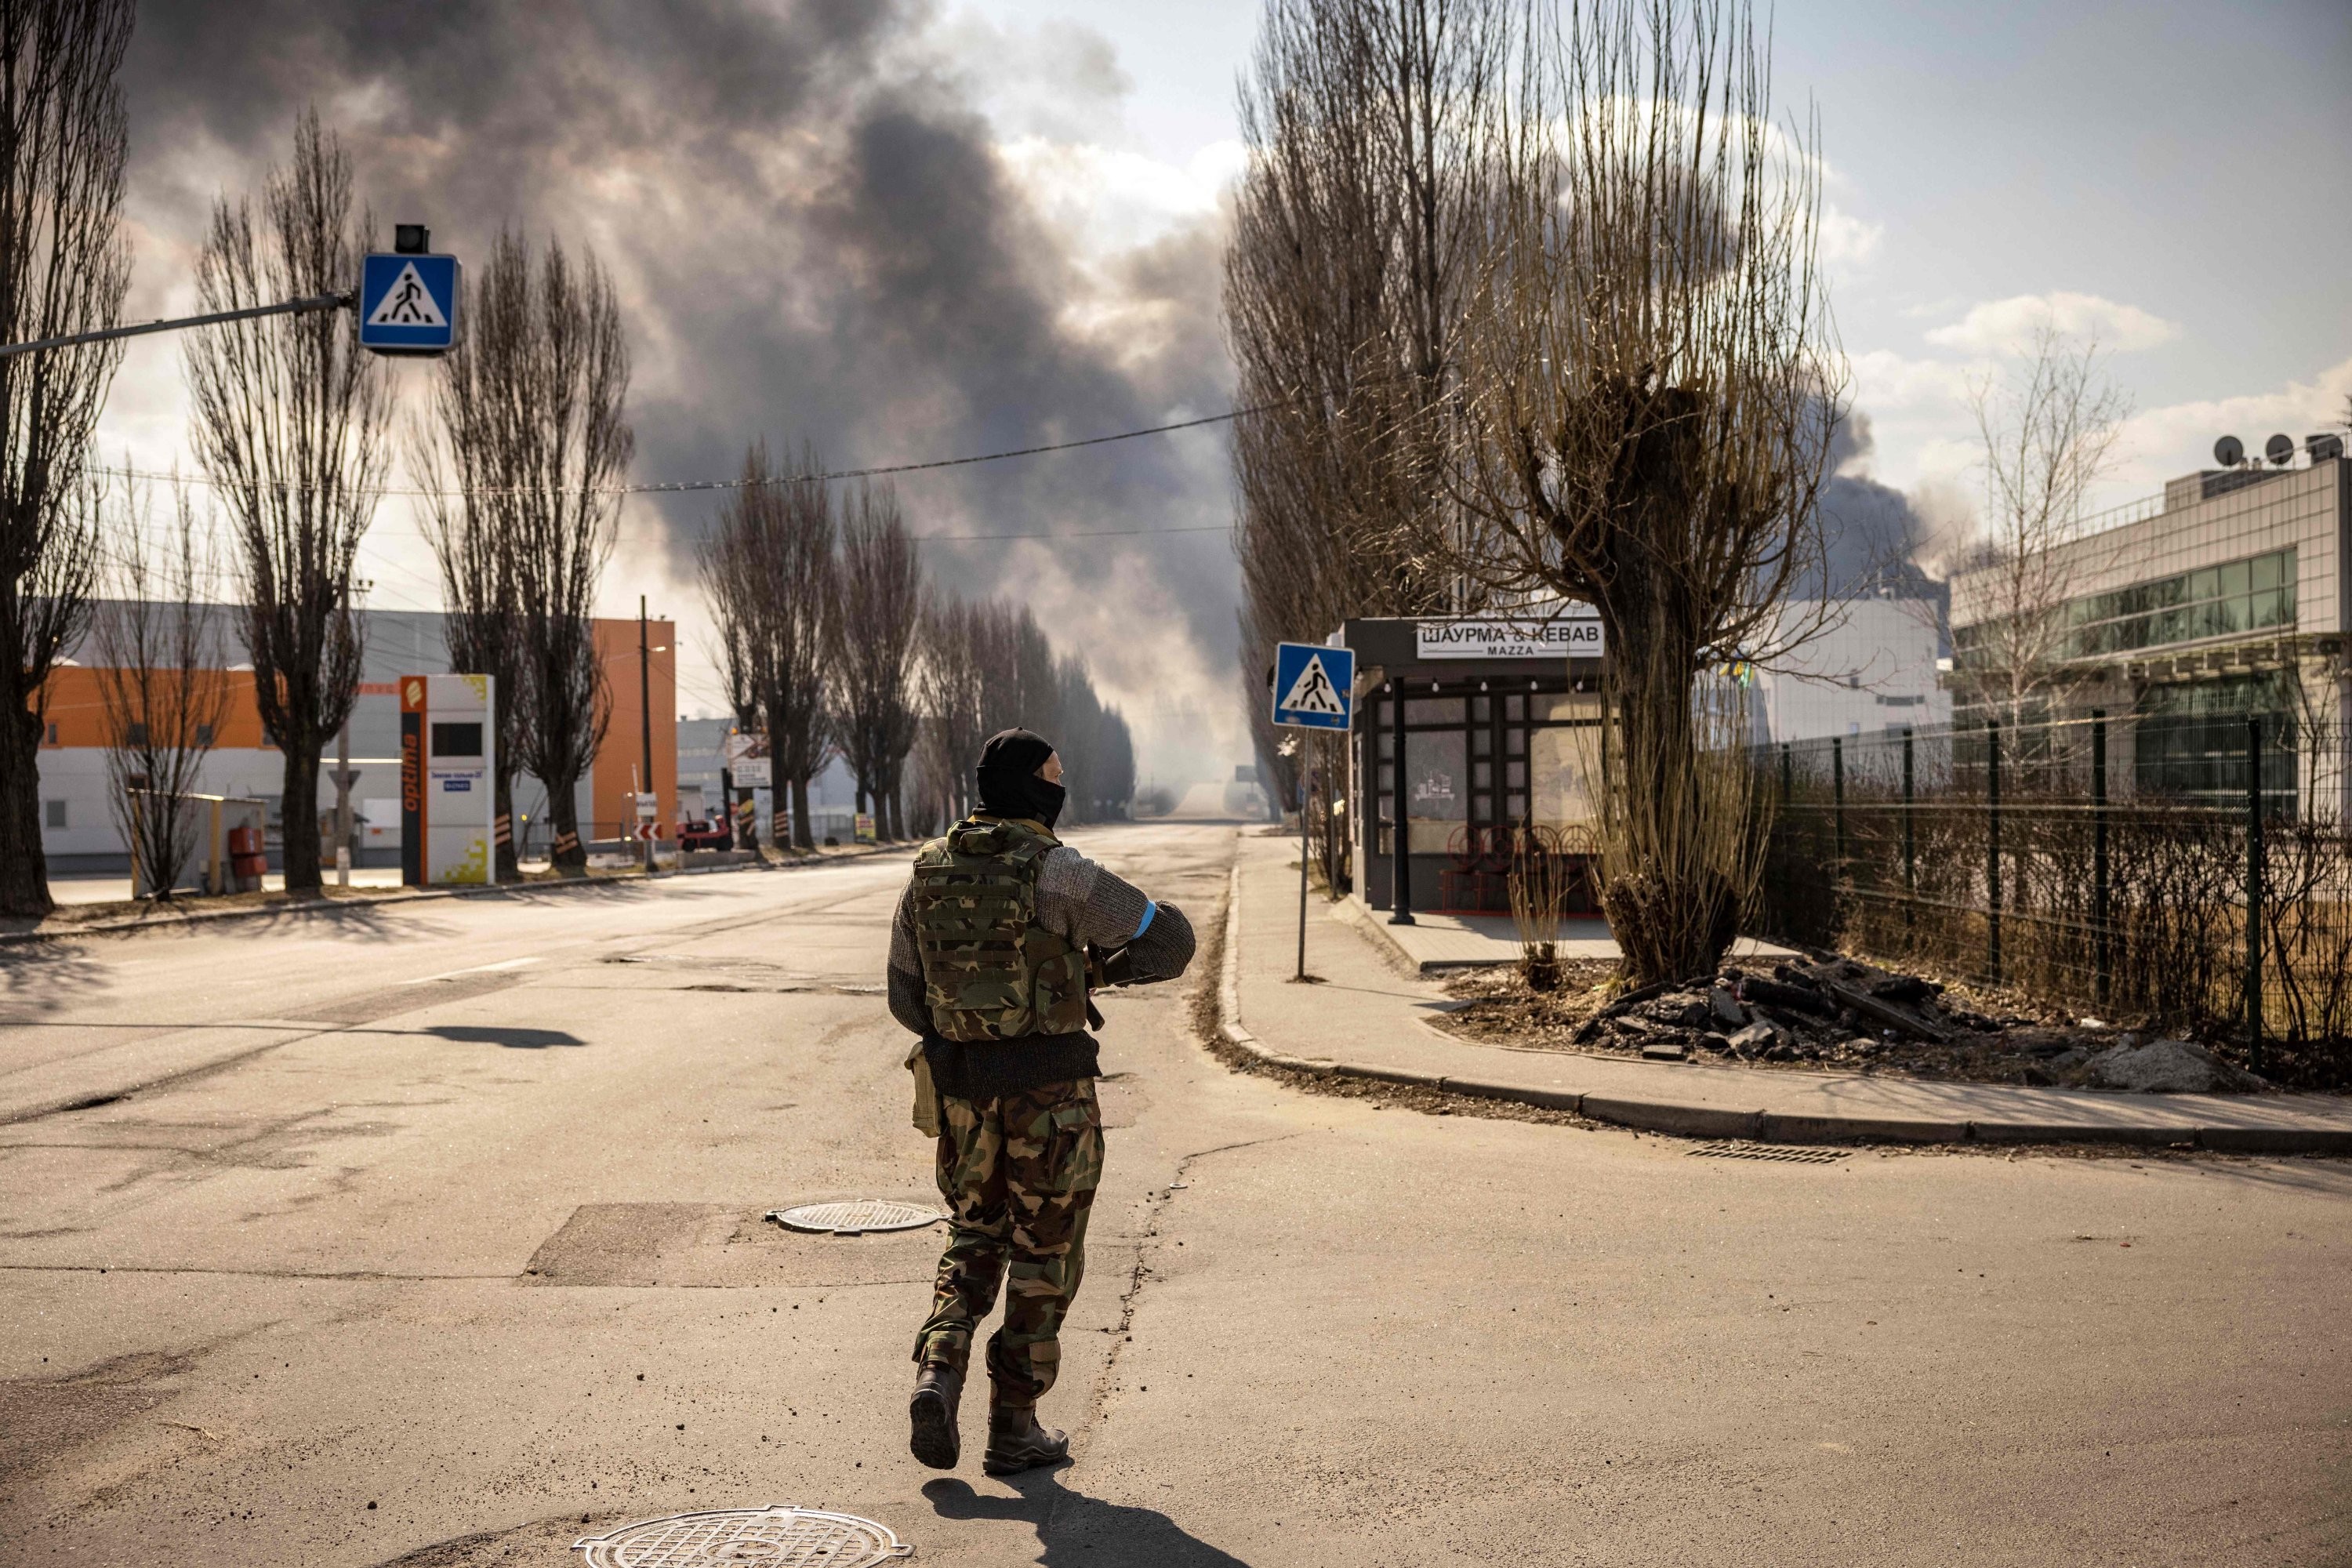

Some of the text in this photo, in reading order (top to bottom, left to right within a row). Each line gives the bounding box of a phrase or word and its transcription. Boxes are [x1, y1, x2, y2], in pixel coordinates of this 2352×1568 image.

[1423, 627, 1505, 642] ШАУРМА
[1487, 646, 1534, 655] MAZZA
[402, 734, 419, 811] optima
